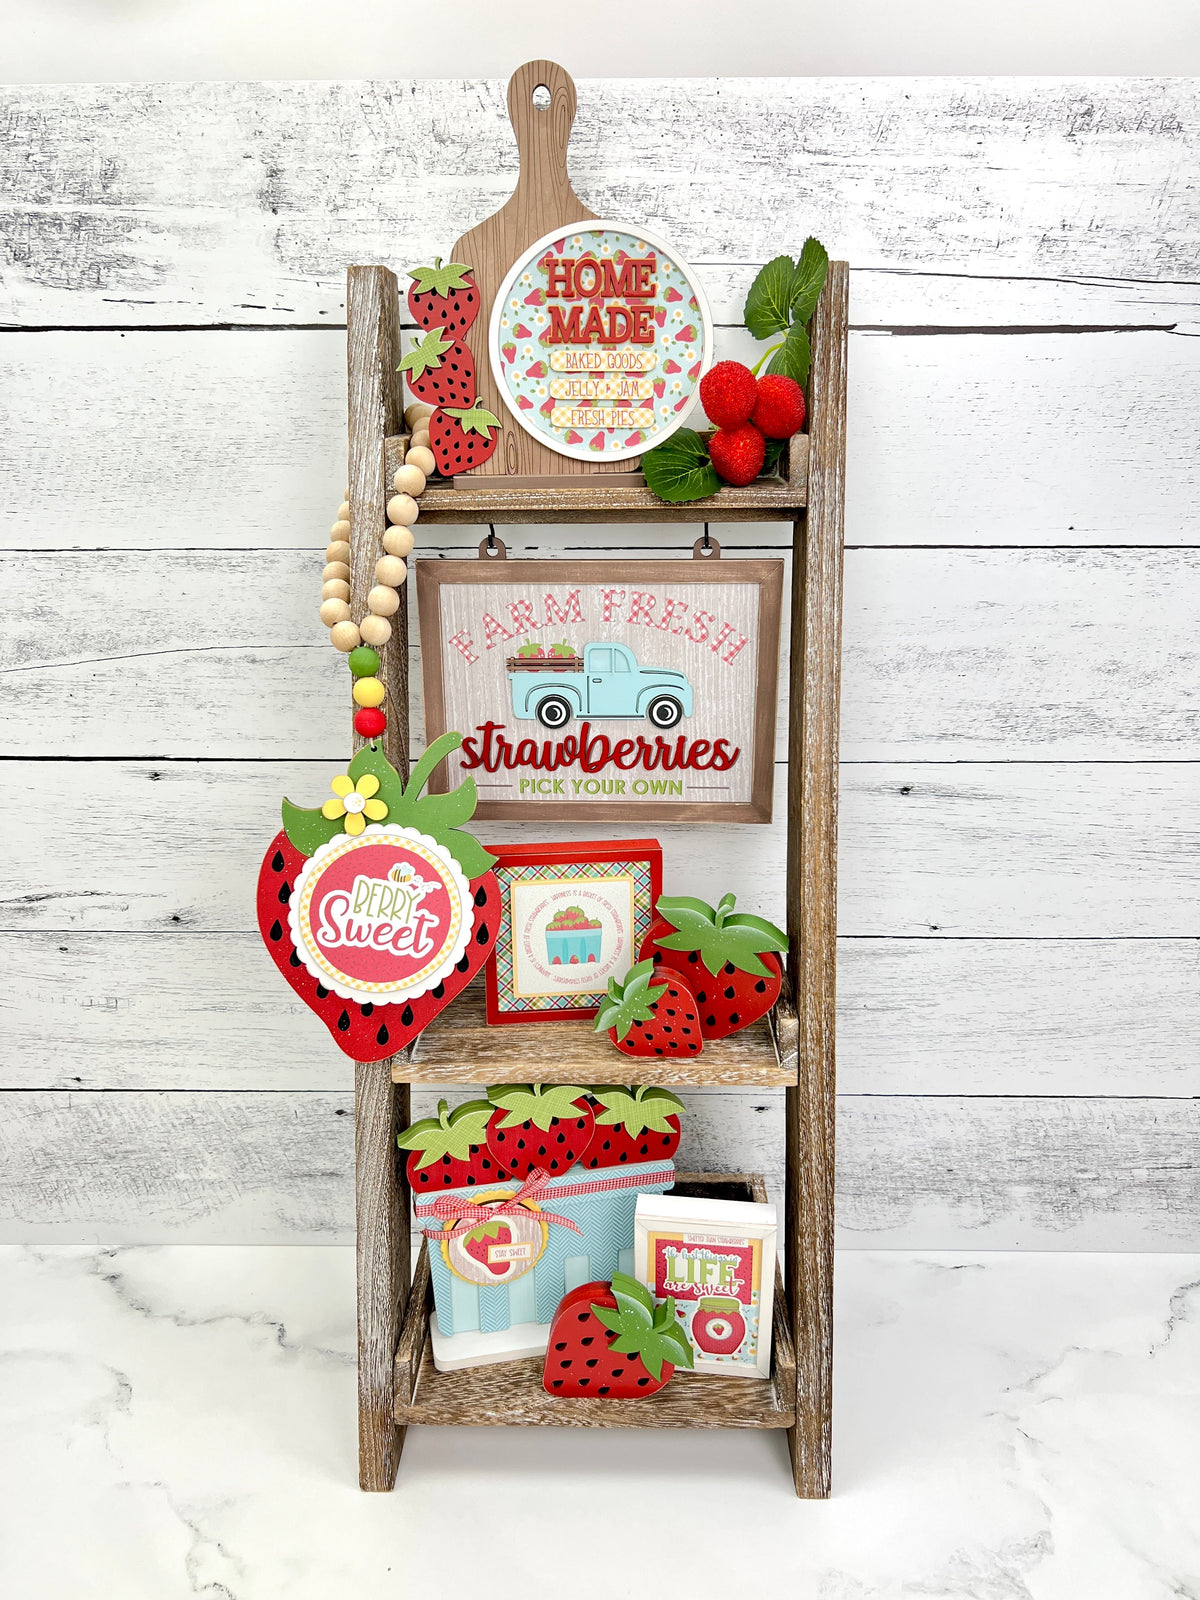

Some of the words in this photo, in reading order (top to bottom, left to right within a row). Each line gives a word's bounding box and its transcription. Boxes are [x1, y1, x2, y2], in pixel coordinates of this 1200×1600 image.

[545, 258, 657, 298] HOME
[547, 305, 655, 344] MADE
[565, 353, 602, 369] BAKED
[607, 353, 643, 369] GOODS
[565, 381, 600, 397] JELLY
[617, 381, 640, 397] JAM
[570, 409, 605, 425] FRESH
[611, 410, 635, 426] PIES
[448, 589, 586, 666] FARM
[600, 588, 750, 666] FRESH
[460, 720, 740, 774] strawberries
[519, 779, 565, 795] PICK
[571, 779, 626, 795] YOUR
[631, 779, 683, 796] OWN
[353, 879, 421, 924] BERRY
[321, 894, 435, 954] Sweet
[494, 1250, 508, 1258] STAY
[510, 1248, 526, 1257] SWEET
[665, 1247, 678, 1258] the
[682, 1249, 699, 1260] best
[666, 1256, 738, 1286] LIFE
[664, 1281, 690, 1291] are
[692, 1275, 744, 1295] sweet
